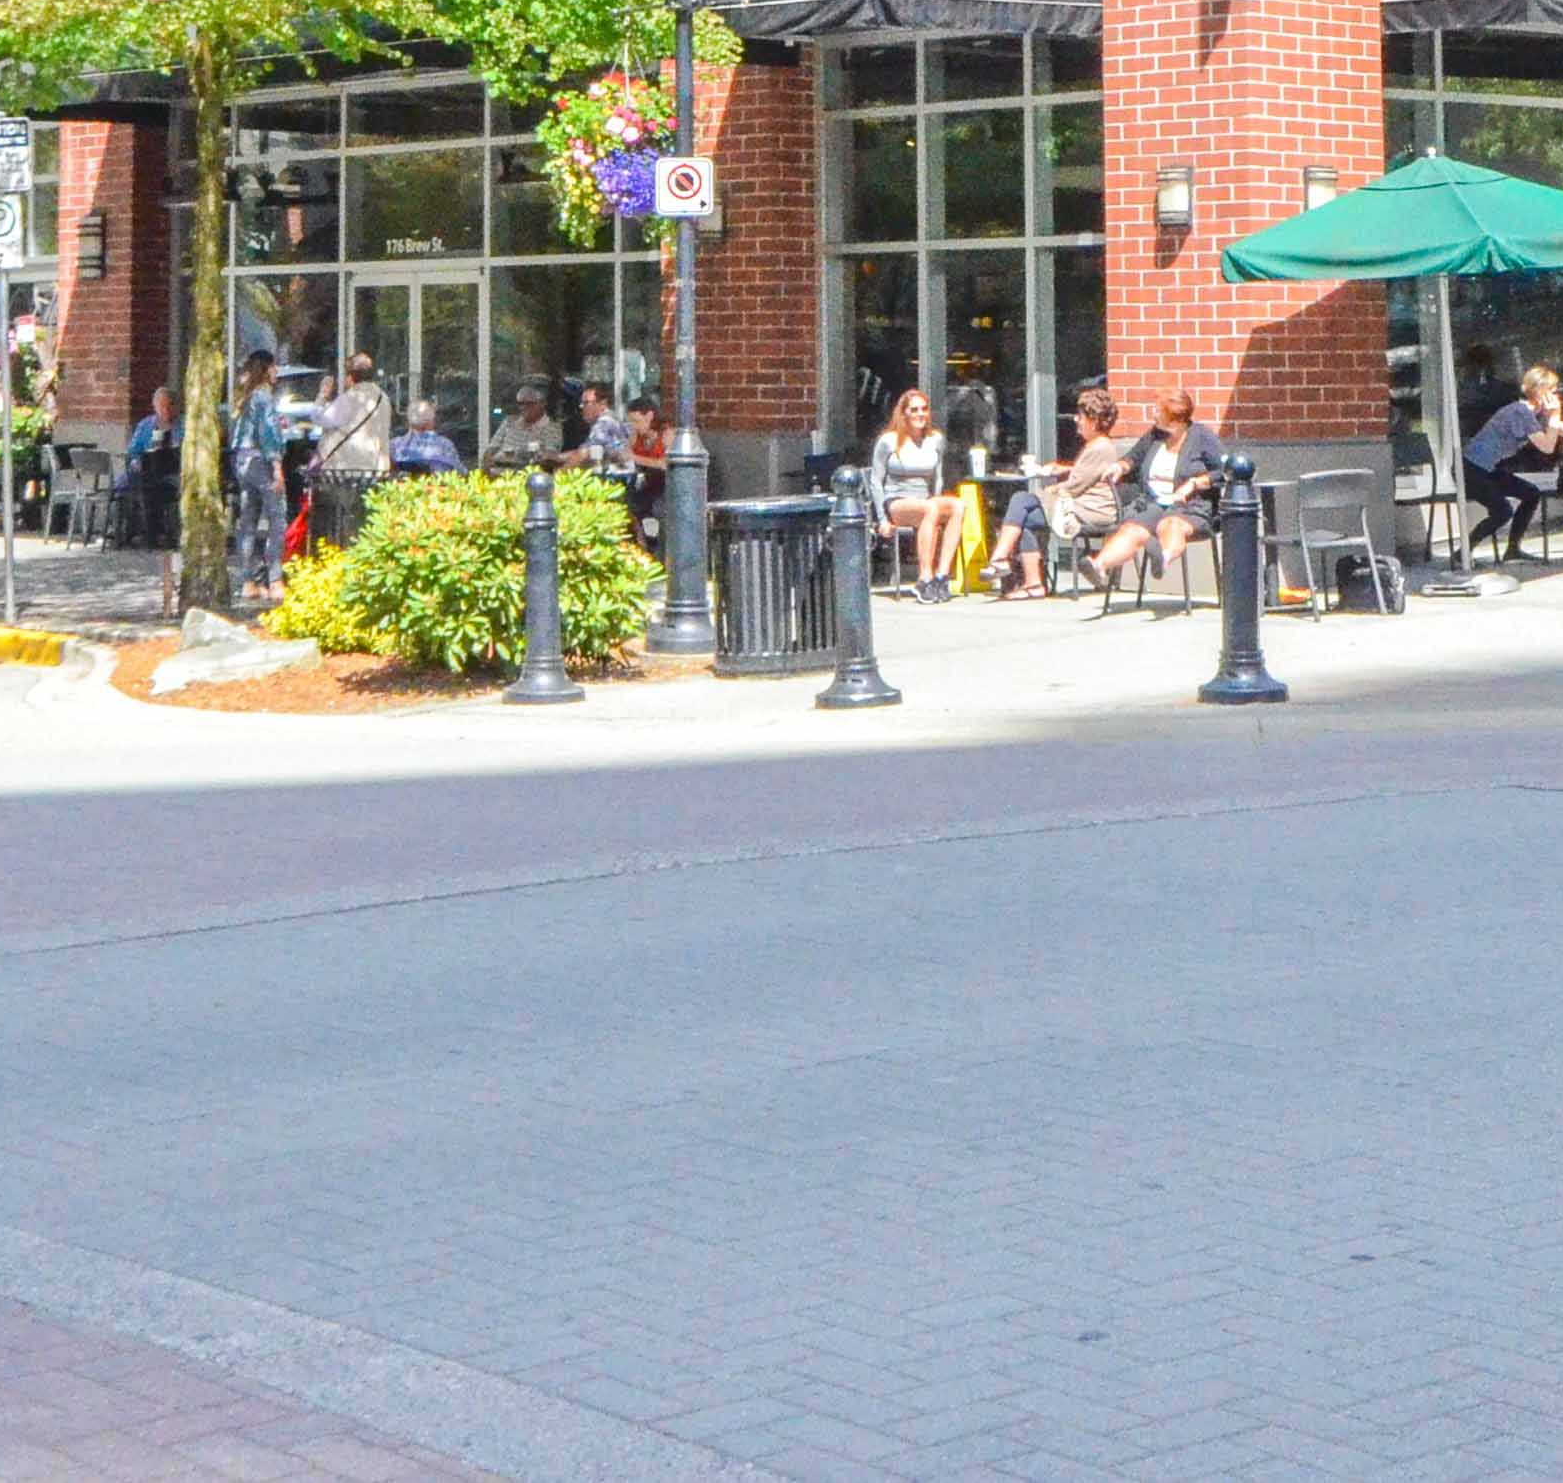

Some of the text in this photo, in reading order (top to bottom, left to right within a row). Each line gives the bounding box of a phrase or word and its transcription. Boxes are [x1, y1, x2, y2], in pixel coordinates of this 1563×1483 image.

[385, 236, 445, 254] 176 Brew St.
